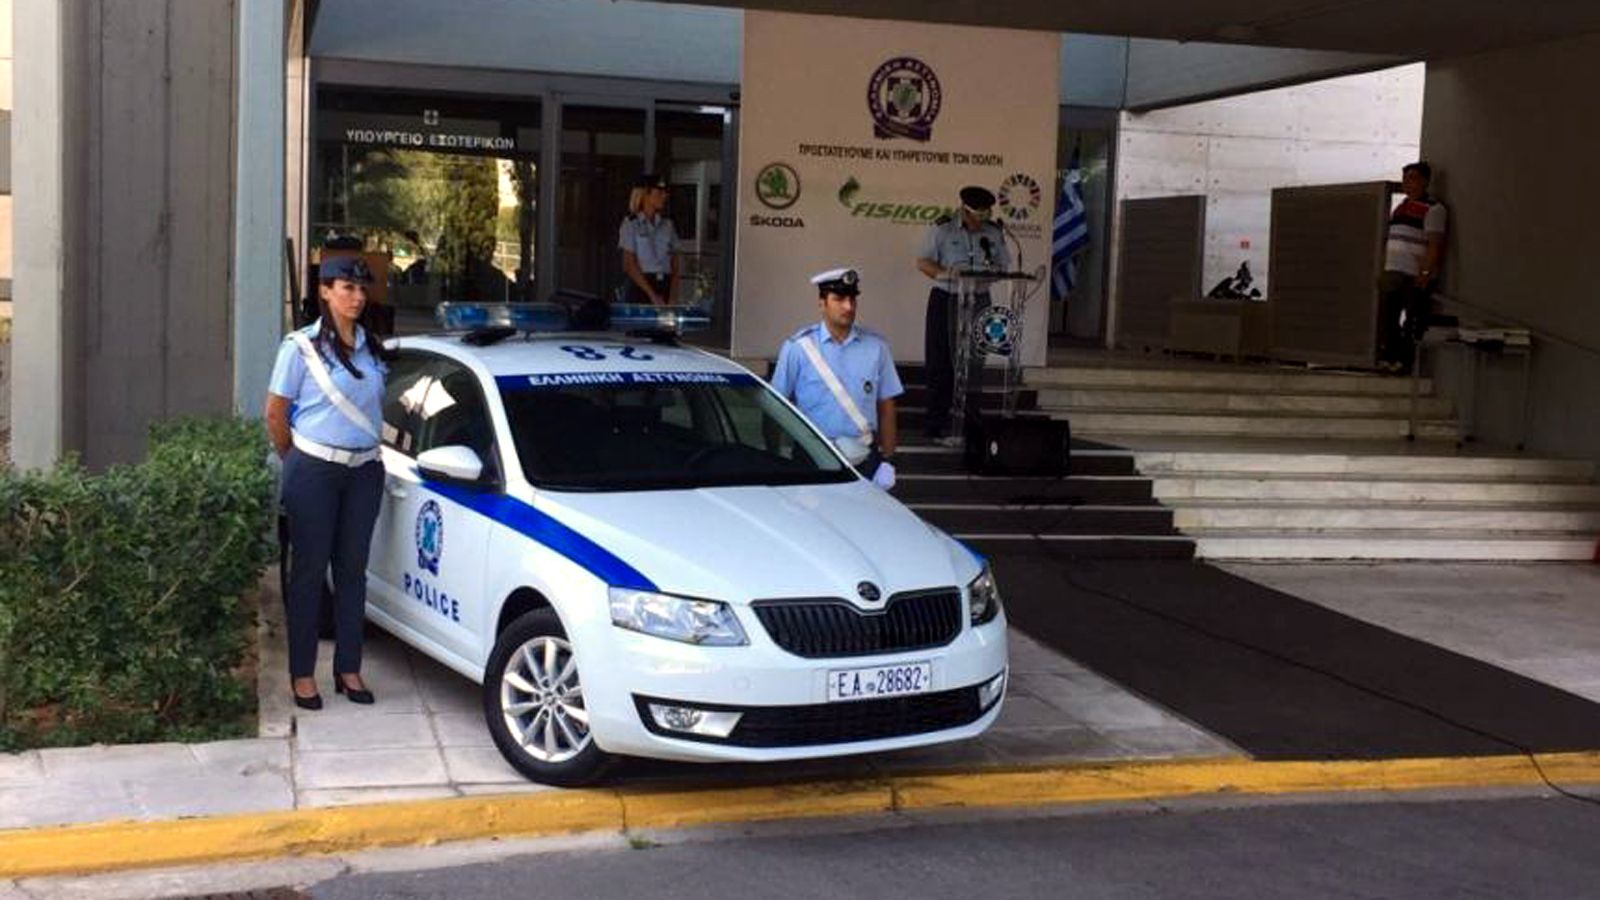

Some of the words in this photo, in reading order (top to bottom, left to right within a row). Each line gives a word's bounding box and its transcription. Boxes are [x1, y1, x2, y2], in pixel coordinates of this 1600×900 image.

[346, 129, 424, 146] ΥΠΟΥΡΓΕΙΟ
[429, 134, 515, 150] ΕΞΩΤΕΡΙΚΩΝ
[528, 372, 624, 386] ΕΛΛΗΝΙΚΗ
[632, 371, 730, 383] ΑΣΤΥΝΟΜΙΑ
[404, 572, 460, 622] POLICE
[877, 666, 921, 693] 28682
